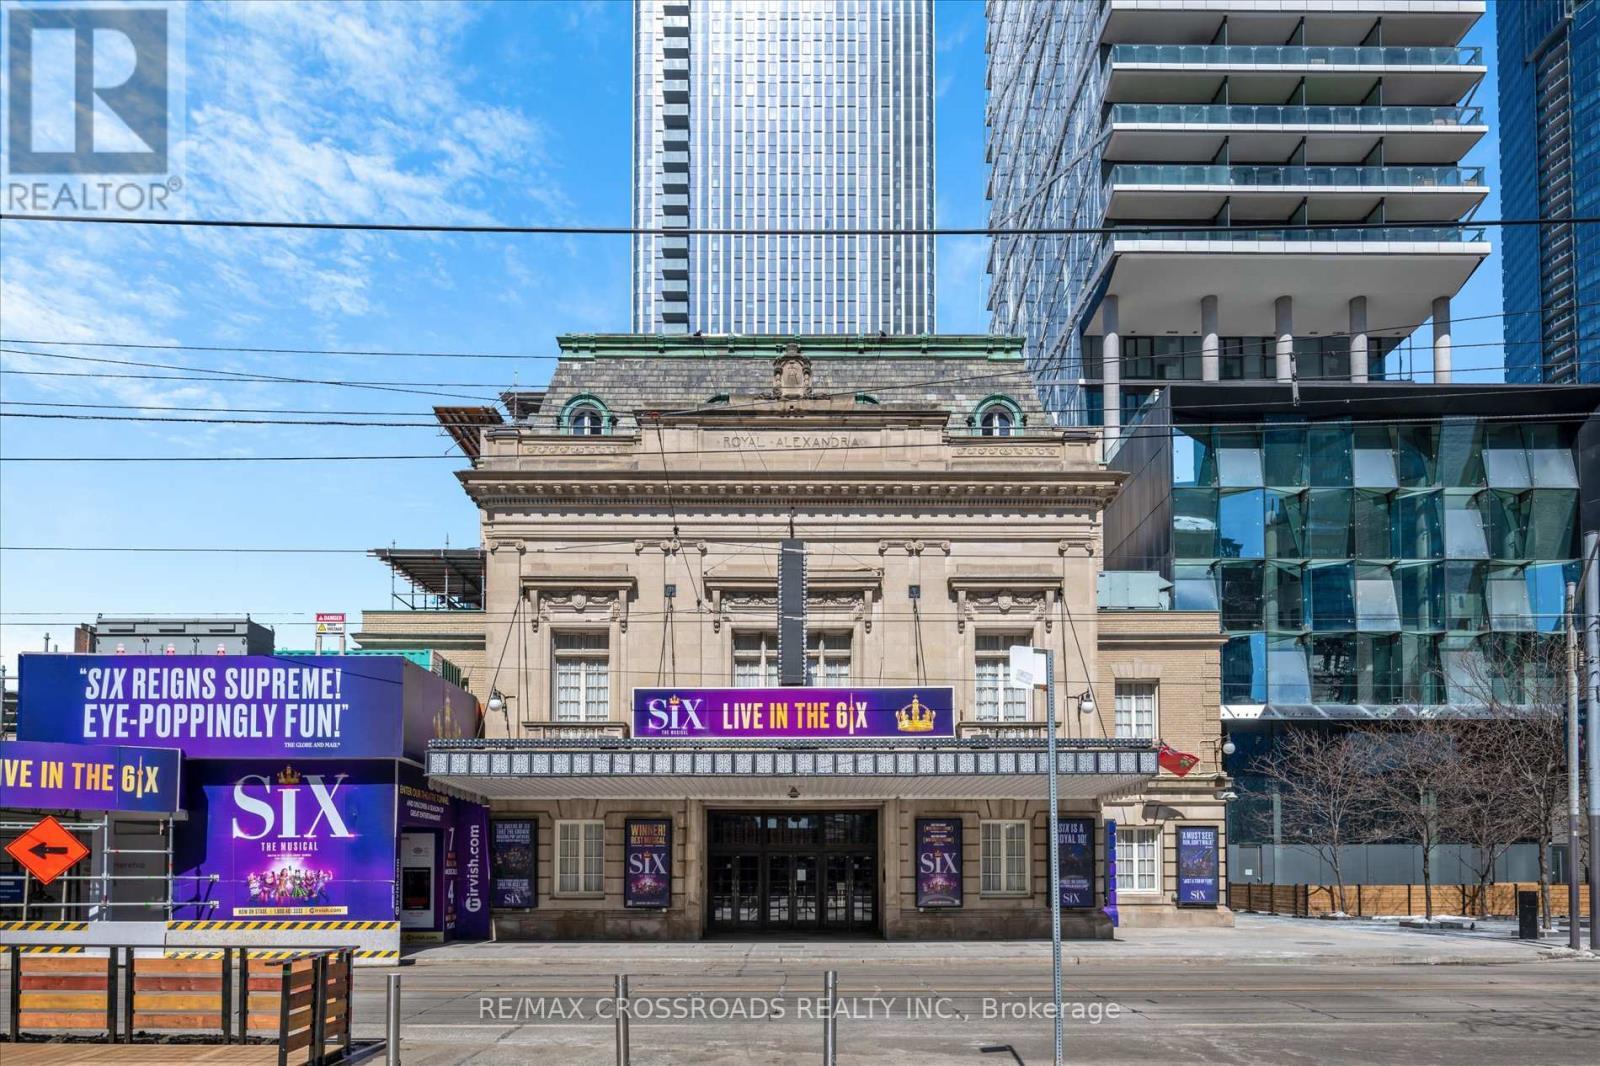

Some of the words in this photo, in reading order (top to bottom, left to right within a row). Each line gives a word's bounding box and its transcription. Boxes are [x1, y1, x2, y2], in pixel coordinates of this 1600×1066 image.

[723, 436, 765, 448] ROYAL
[776, 436, 860, 448] ALEXANDRA
[132, 668, 216, 700] REIGNS
[225, 668, 342, 700] SUPREME!
[83, 703, 278, 738] EYE-POPPINGLY
[723, 702, 763, 730] LIVE
[770, 702, 788, 729] IN
[794, 702, 829, 729] THE
[40, 761, 64, 789] IN
[72, 763, 114, 791] THE
[630, 824, 666, 836] WINNER!
[1079, 823, 1084, 833] A
[631, 836, 644, 845] BEST
[644, 836, 666, 845] MUSICAL
[1058, 834, 1076, 844] OYAL
[1187, 831, 1201, 840] MUST
[261, 842, 276, 851] THE
[281, 841, 319, 851] MUSICAL
